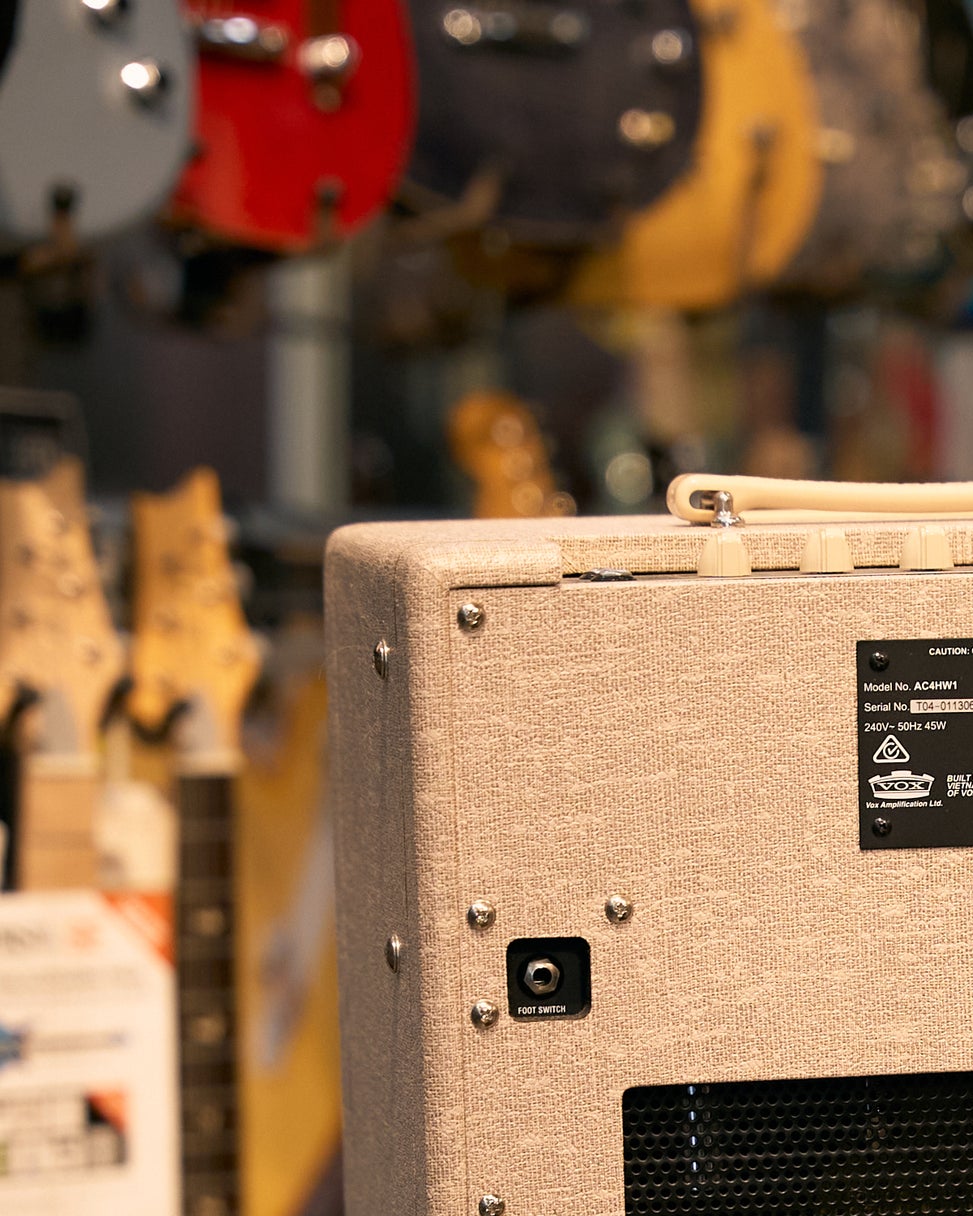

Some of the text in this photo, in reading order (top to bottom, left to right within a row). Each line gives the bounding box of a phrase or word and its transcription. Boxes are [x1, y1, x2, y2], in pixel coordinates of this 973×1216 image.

[928, 647, 970, 656] CAUTION:
[863, 681, 958, 692] Model No. AC4HW1
[864, 702, 891, 712] Serial
[893, 702, 910, 712] No.
[864, 721, 947, 732] 240V~ 50Hz 45W
[946, 774, 971, 782] BUILT
[877, 781, 925, 790] VOX
[946, 789, 960, 798] OF
[865, 799, 943, 809] Vox Amplification Ltd.
[517, 1005, 566, 1015] FOOT SWITCH
